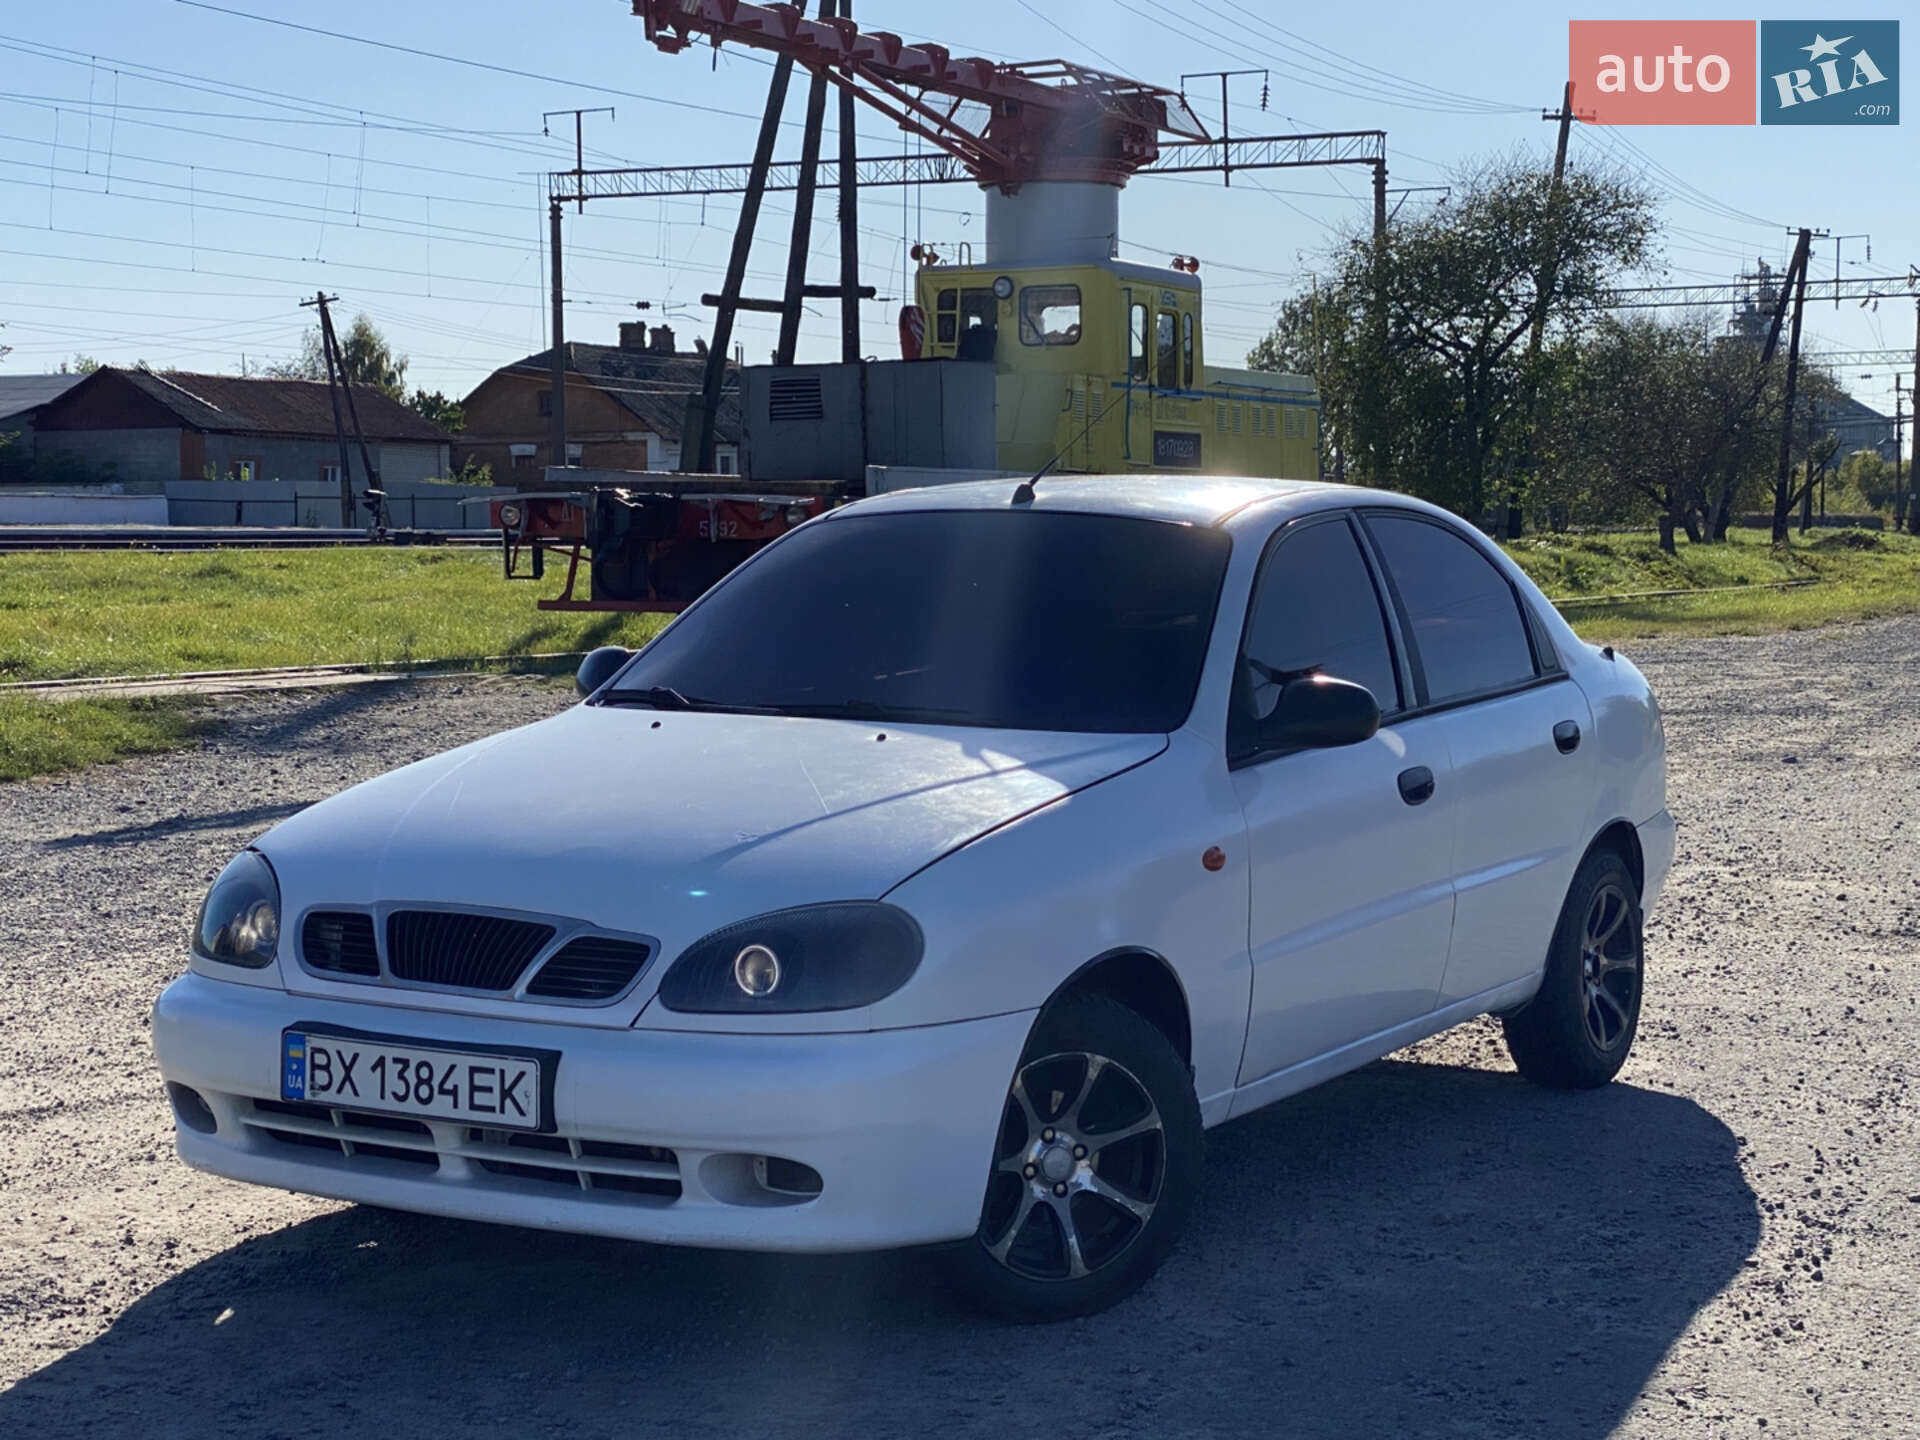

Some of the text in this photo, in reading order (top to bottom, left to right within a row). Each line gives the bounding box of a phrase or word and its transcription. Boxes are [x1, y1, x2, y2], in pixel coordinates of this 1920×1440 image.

[698, 519, 737, 537] 592
[287, 1074, 303, 1090] UA
[309, 1046, 527, 1117] BX 1384 EK
